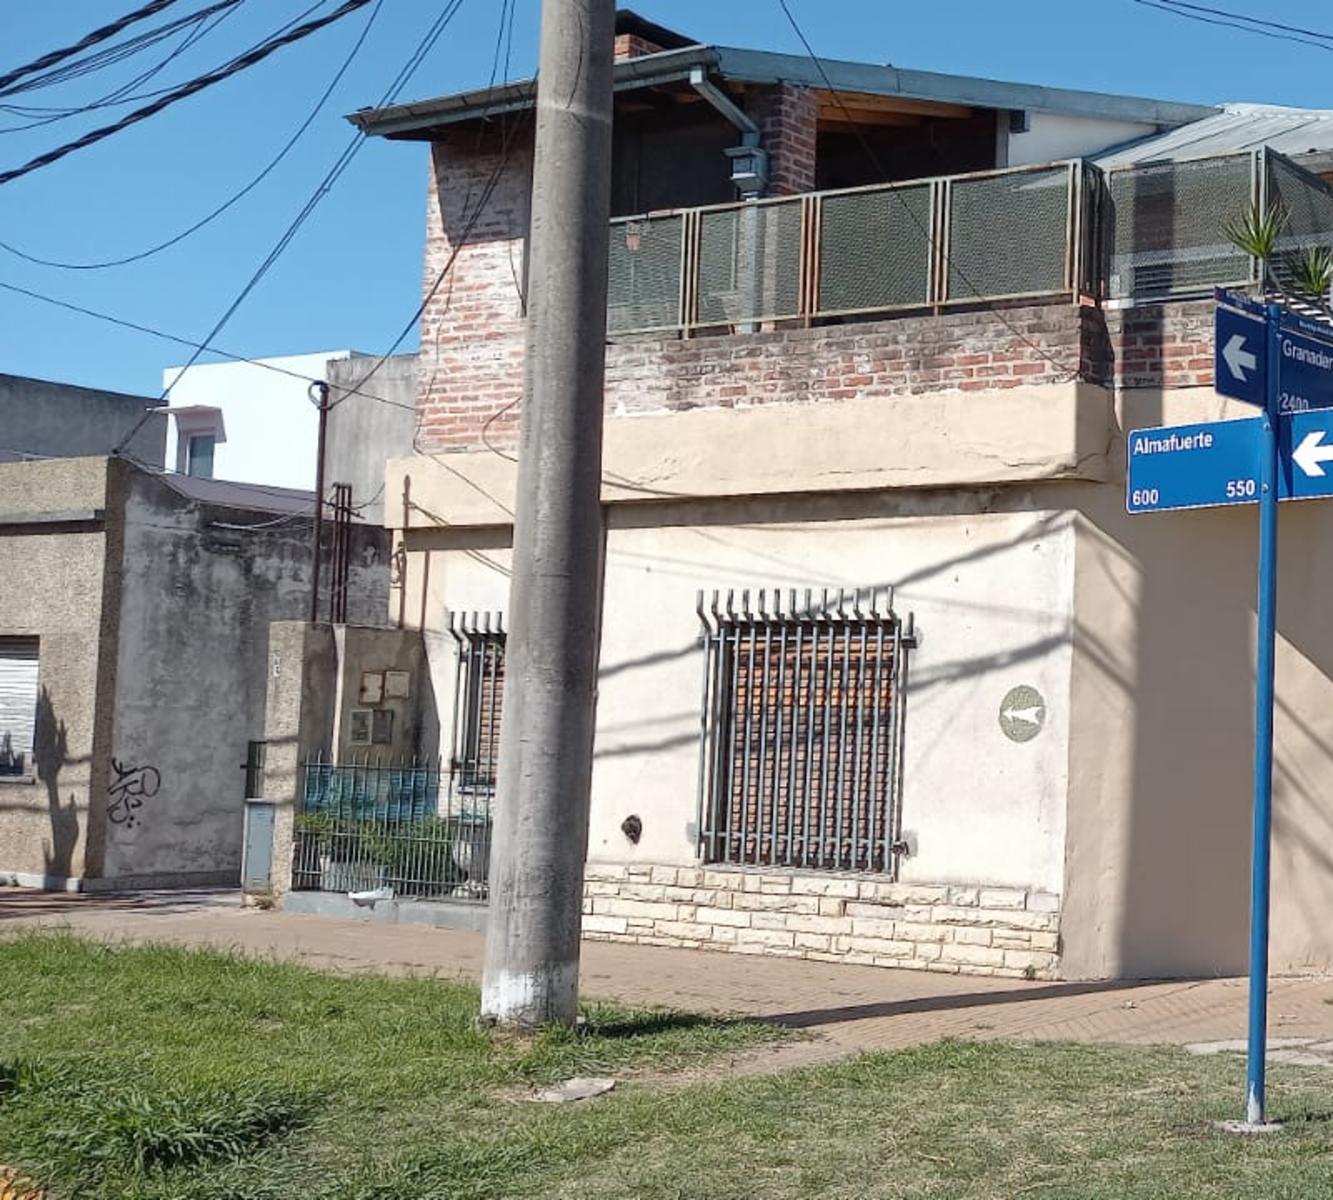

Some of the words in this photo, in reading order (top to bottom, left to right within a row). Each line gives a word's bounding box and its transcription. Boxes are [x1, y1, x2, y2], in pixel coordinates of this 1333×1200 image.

[1281, 392, 1309, 410] 2400
[1133, 432, 1213, 455] Almafuerte
[1132, 489, 1159, 505] 600
[1226, 479, 1256, 497] 550
